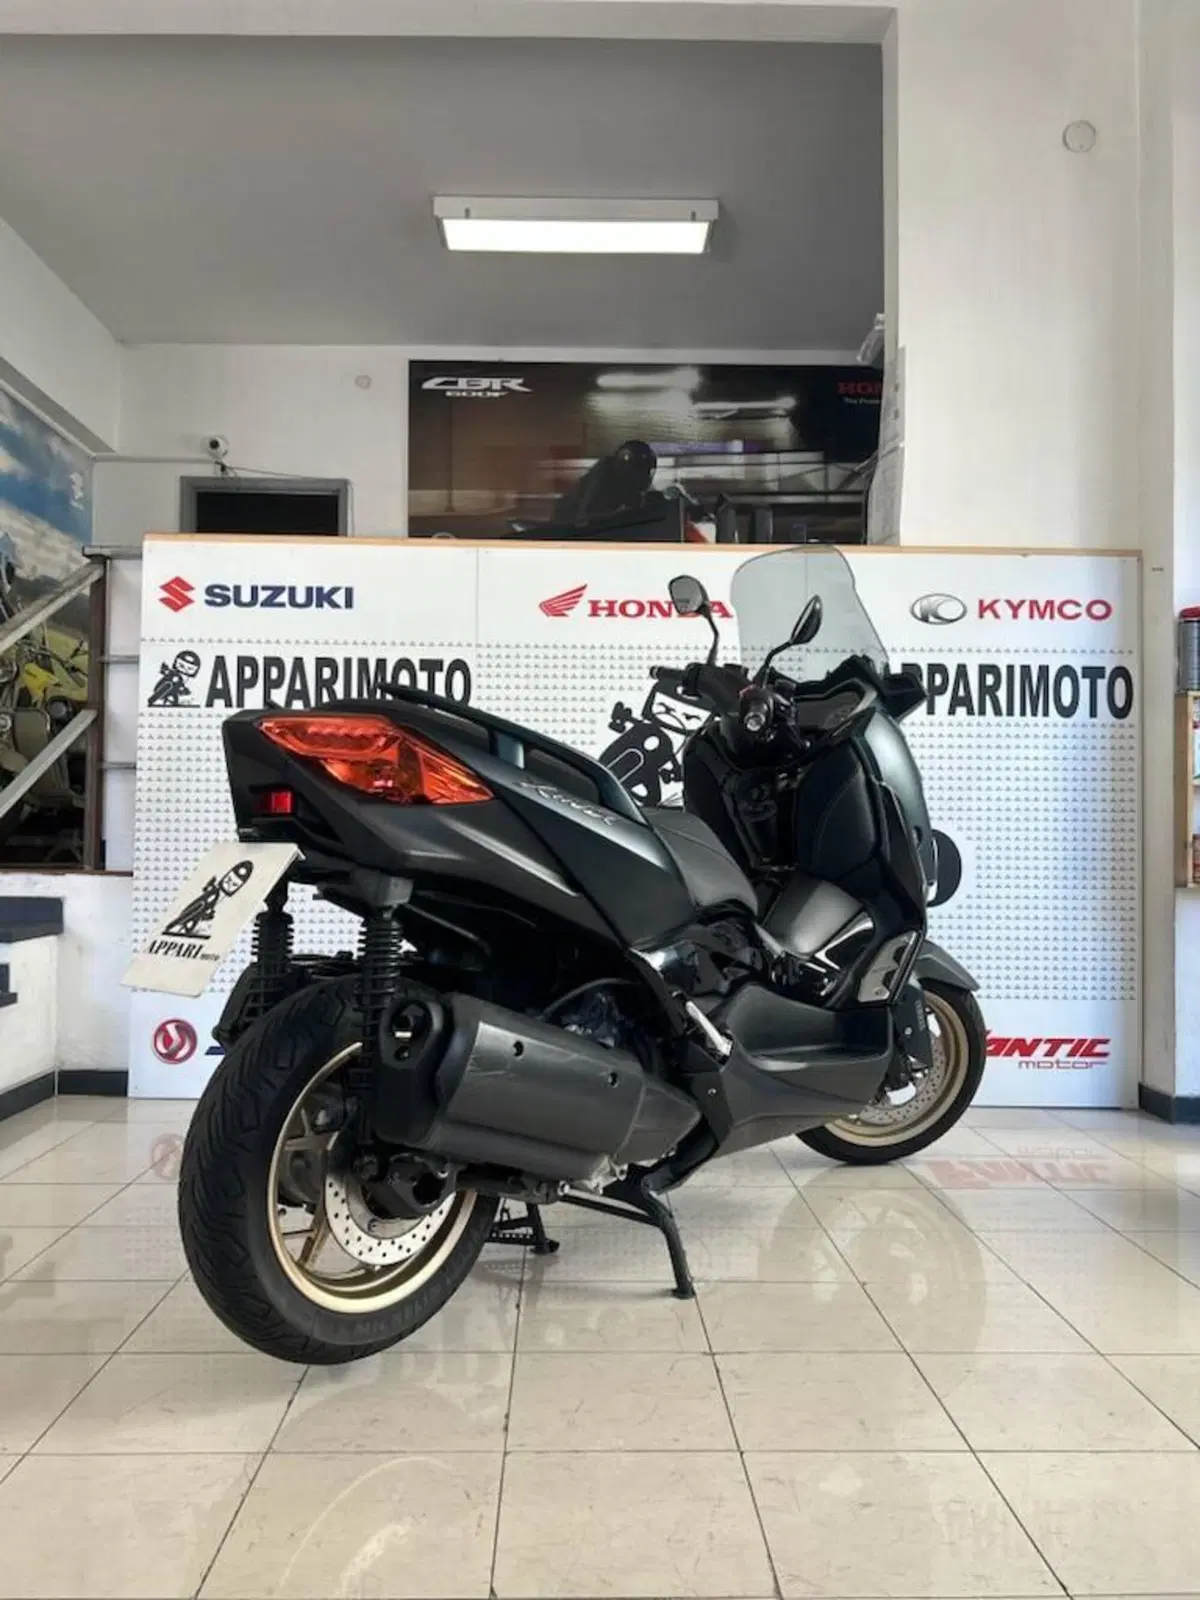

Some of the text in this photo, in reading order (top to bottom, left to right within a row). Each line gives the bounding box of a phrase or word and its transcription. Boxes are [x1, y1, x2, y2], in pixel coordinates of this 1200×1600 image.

[421, 376, 533, 393] CBR
[204, 584, 354, 609] SUZUKI
[588, 600, 733, 618] HONA
[977, 599, 1112, 620] KYMCO
[205, 655, 472, 708] APPARIMOTO
[149, 940, 204, 959] APPARI
[984, 1037, 1110, 1057] ANTIC
[1018, 1060, 1108, 1069] motor
